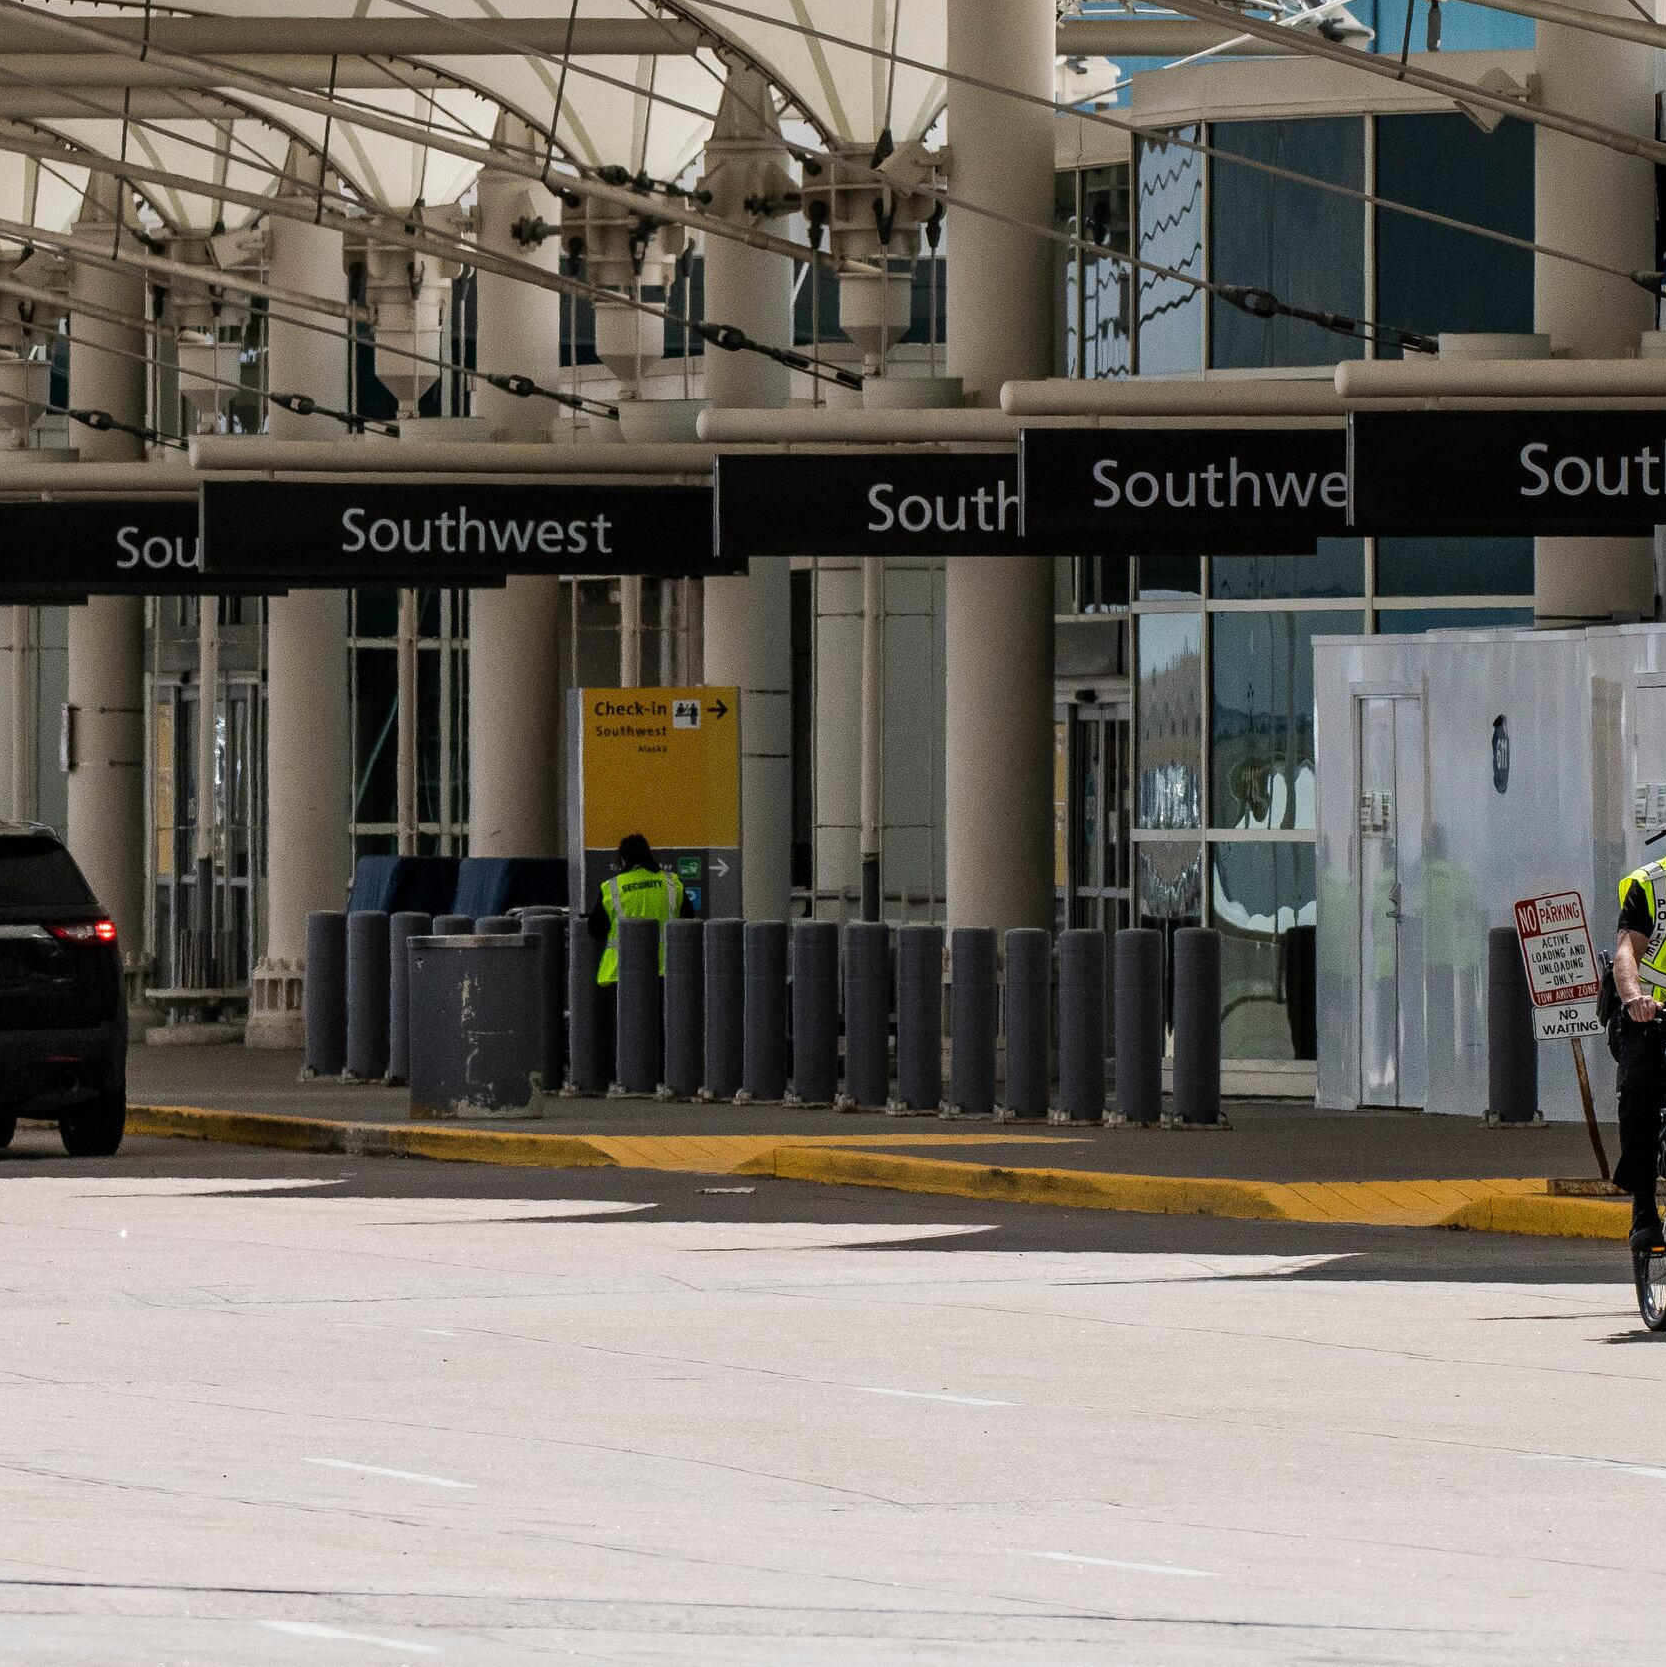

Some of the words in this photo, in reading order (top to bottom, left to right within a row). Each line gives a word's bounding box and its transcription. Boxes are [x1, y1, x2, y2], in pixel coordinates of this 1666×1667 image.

[1093, 457, 1349, 508] Southwe
[342, 506, 613, 553] Southwest
[595, 701, 668, 716] Check-in
[596, 725, 667, 737] Southwest
[1517, 904, 1538, 934] NO
[1539, 901, 1580, 925] PARKING
[1542, 934, 1570, 949] ACTIVE
[1530, 947, 1566, 964] LOADING
[1569, 944, 1586, 957] AND
[1538, 957, 1584, 976] UNLOADING
[1536, 992, 1553, 1005] TOW
[1577, 983, 1598, 997] ZONE
[1559, 1009, 1579, 1021] NO
[1542, 1020, 1599, 1036] WAITING
